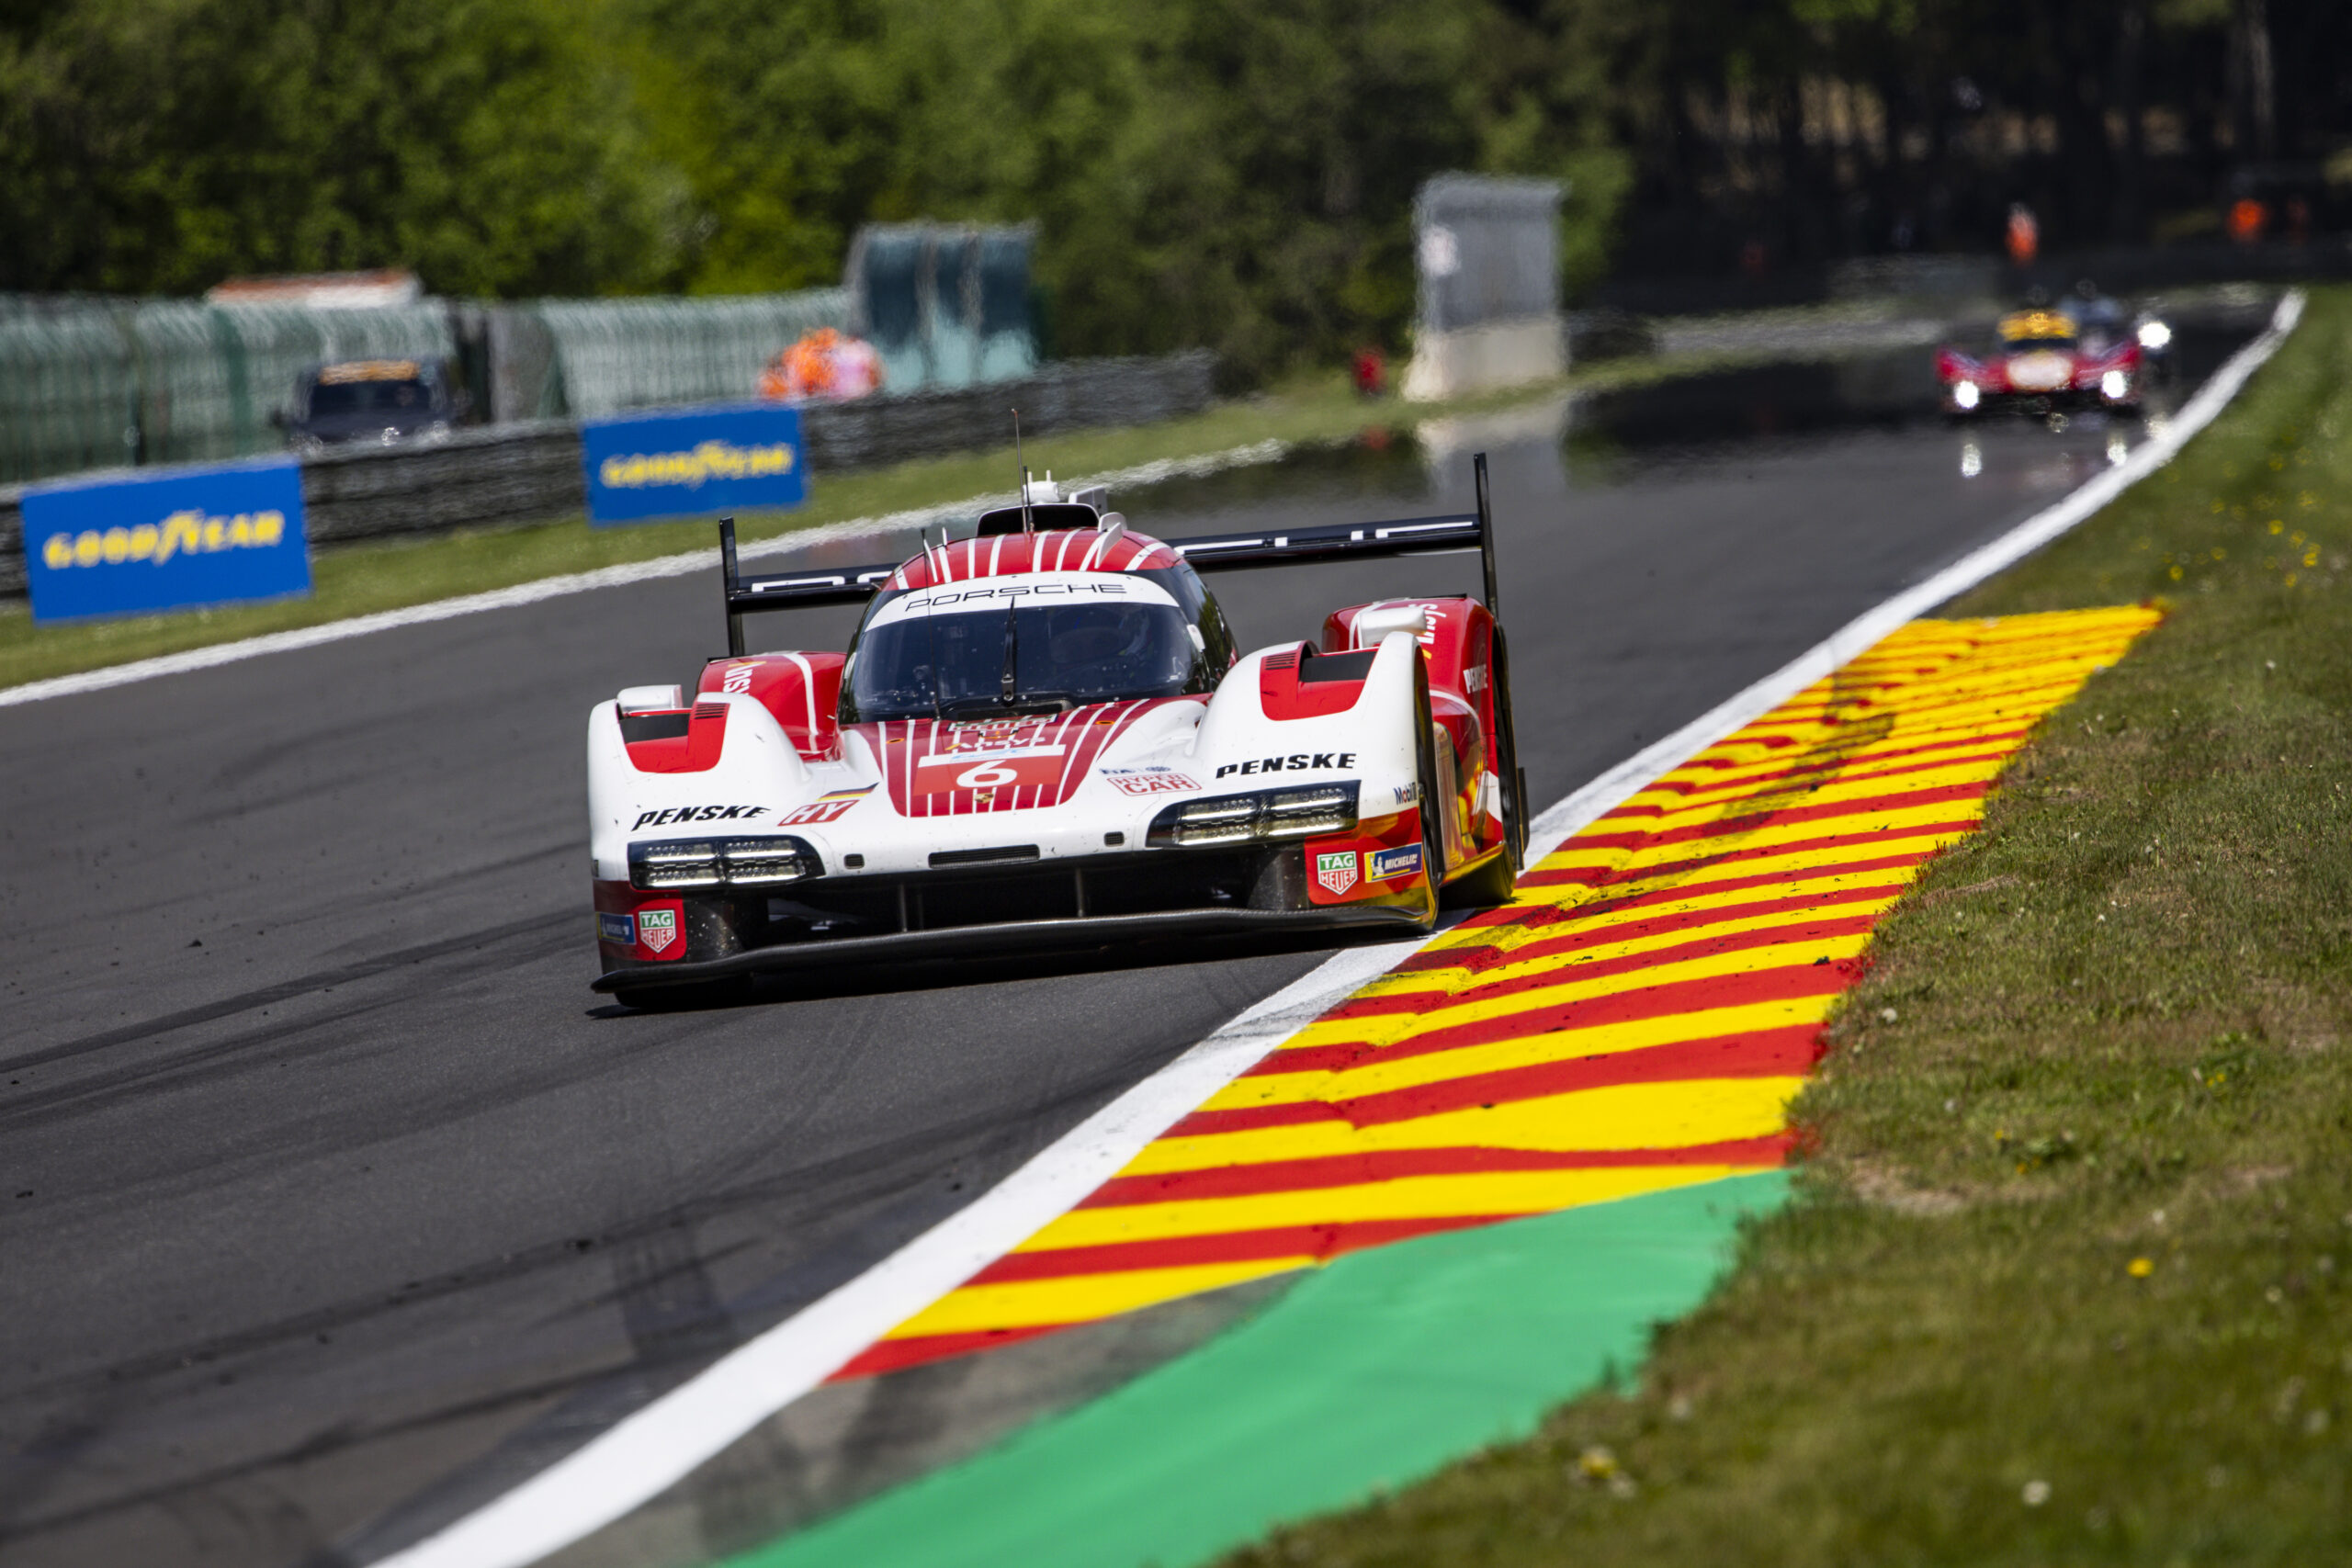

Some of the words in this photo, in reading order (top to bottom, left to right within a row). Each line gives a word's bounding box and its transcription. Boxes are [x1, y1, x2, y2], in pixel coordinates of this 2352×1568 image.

[42, 508, 284, 570] GOODYEAR
[905, 584, 1126, 612] PORSCHE
[956, 759, 1019, 788] 6
[1216, 752, 1357, 779] PENSKE
[1124, 779, 1194, 794] CAR
[631, 806, 771, 831] PENSKE
[785, 801, 855, 825] HY
[1320, 854, 1353, 870] TAG
[1321, 870, 1355, 891] HEUER
[642, 914, 673, 928] TAG
[641, 929, 673, 949] HEUER
